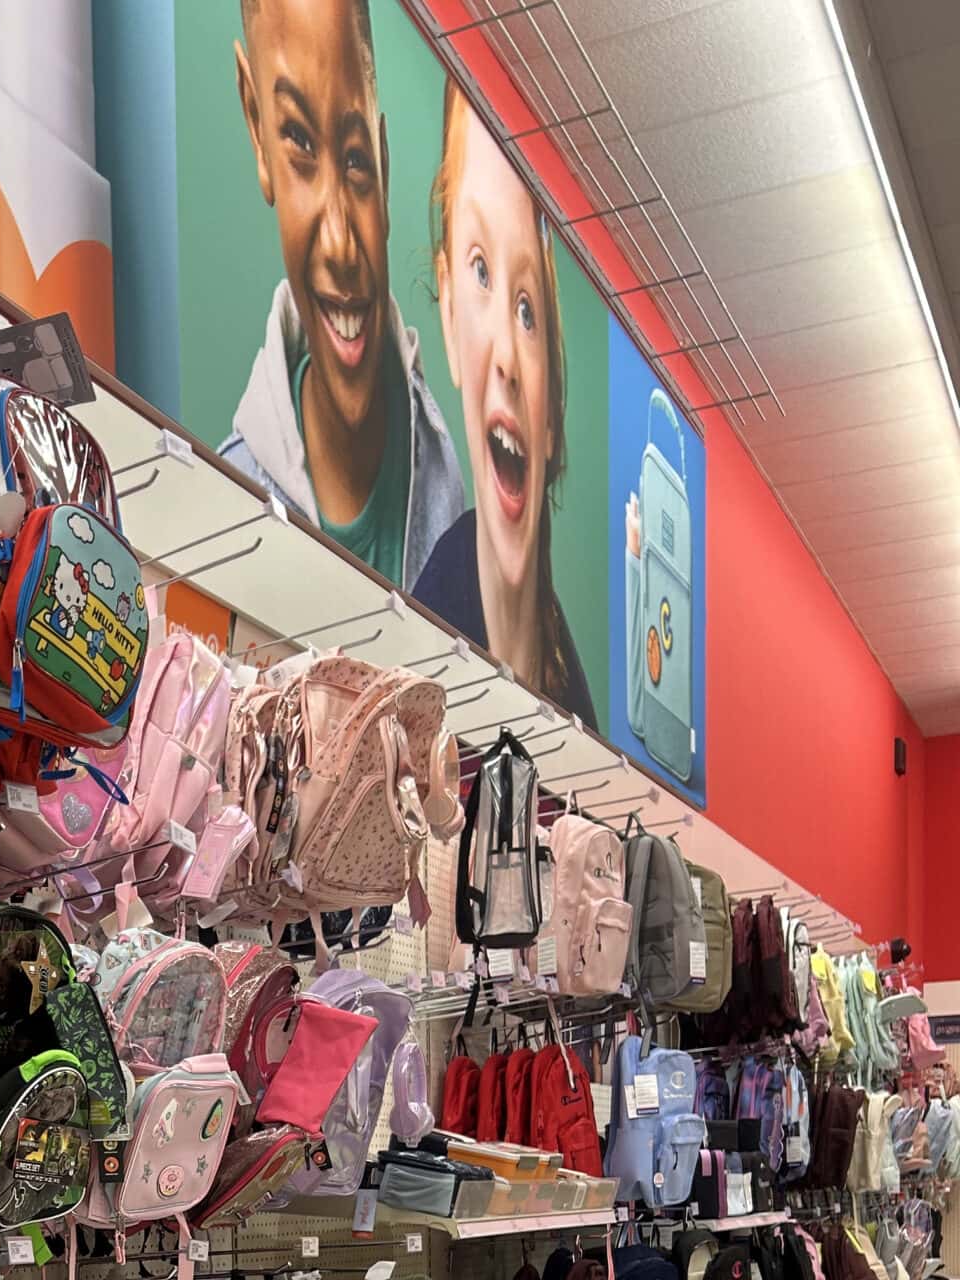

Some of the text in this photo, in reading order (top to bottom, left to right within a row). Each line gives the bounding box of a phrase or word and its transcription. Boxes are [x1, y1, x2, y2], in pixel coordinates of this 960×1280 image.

[91, 606, 136, 655] HELLO KITTY
[659, 596, 673, 656] C
